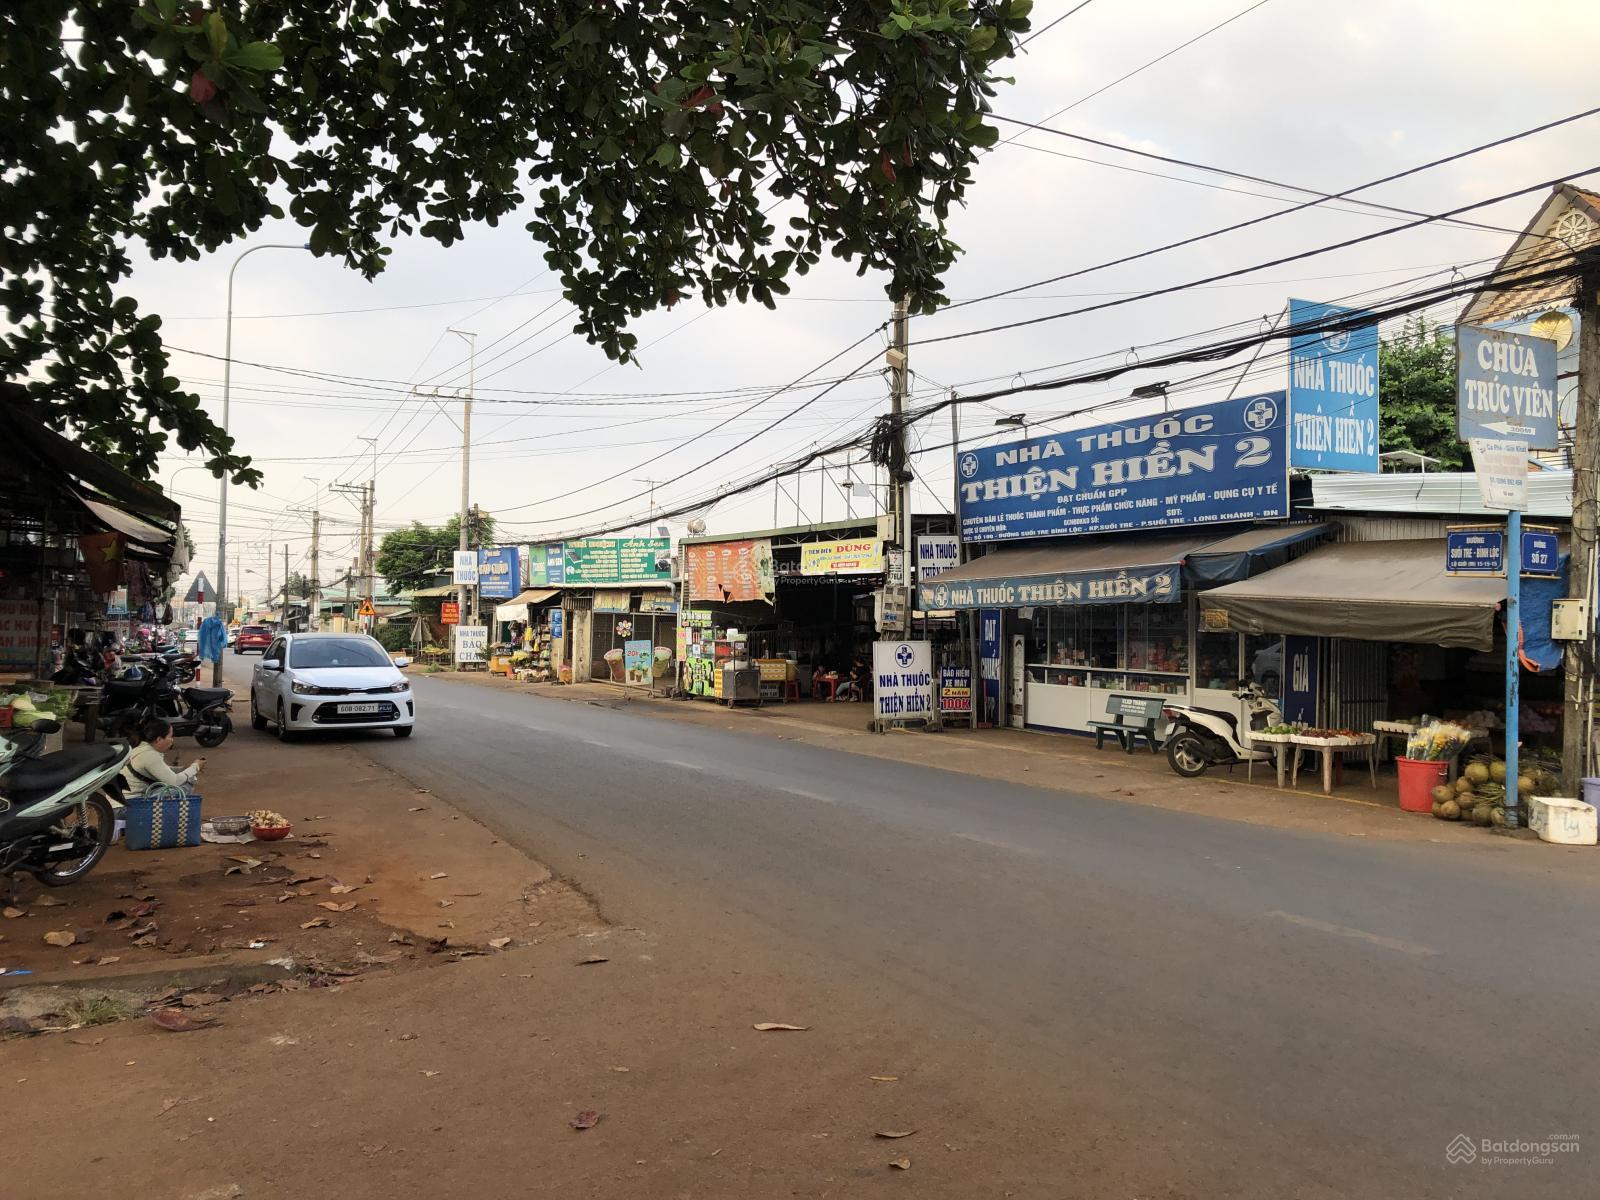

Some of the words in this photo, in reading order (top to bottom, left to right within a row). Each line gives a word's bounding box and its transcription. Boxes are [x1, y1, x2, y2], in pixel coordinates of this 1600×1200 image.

[1477, 337, 1539, 378] CHÙA
[1294, 352, 1325, 391] NHÀ
[1329, 353, 1375, 397] THUỐC
[1464, 375, 1510, 414] TRÚC
[1512, 381, 1553, 418] VIÊN
[995, 439, 1065, 467] NHÀ
[1076, 413, 1214, 452] THUỐC
[1294, 404, 1332, 462] THIỆN
[1366, 418, 1374, 457] 2
[961, 466, 1079, 503] THIỆN
[1235, 436, 1272, 469] 2
[1108, 488, 1127, 497] GPP
[1257, 486, 1263, 495] Y
[1194, 514, 1218, 522] LONG
[1220, 511, 1254, 520] KHÁNH
[920, 541, 934, 559] NHÀ
[935, 540, 957, 559] THUỐC
[1531, 551, 1539, 564] SỐ
[1540, 554, 1548, 564] 27
[952, 587, 973, 605] NHÀ
[977, 582, 1014, 604] THUỐC
[1018, 579, 1083, 607] THIỆN
[1155, 575, 1172, 596] 2
[984, 619, 996, 647] ĐẠT
[879, 671, 899, 688] NHÀ
[901, 668, 930, 687] THUỐC
[1292, 646, 1309, 693] GIÁ
[945, 679, 953, 687] XE
[954, 679, 968, 687] MÁY
[879, 692, 904, 717] THIỆN
[926, 694, 931, 712] 2
[942, 698, 970, 710] 100K
